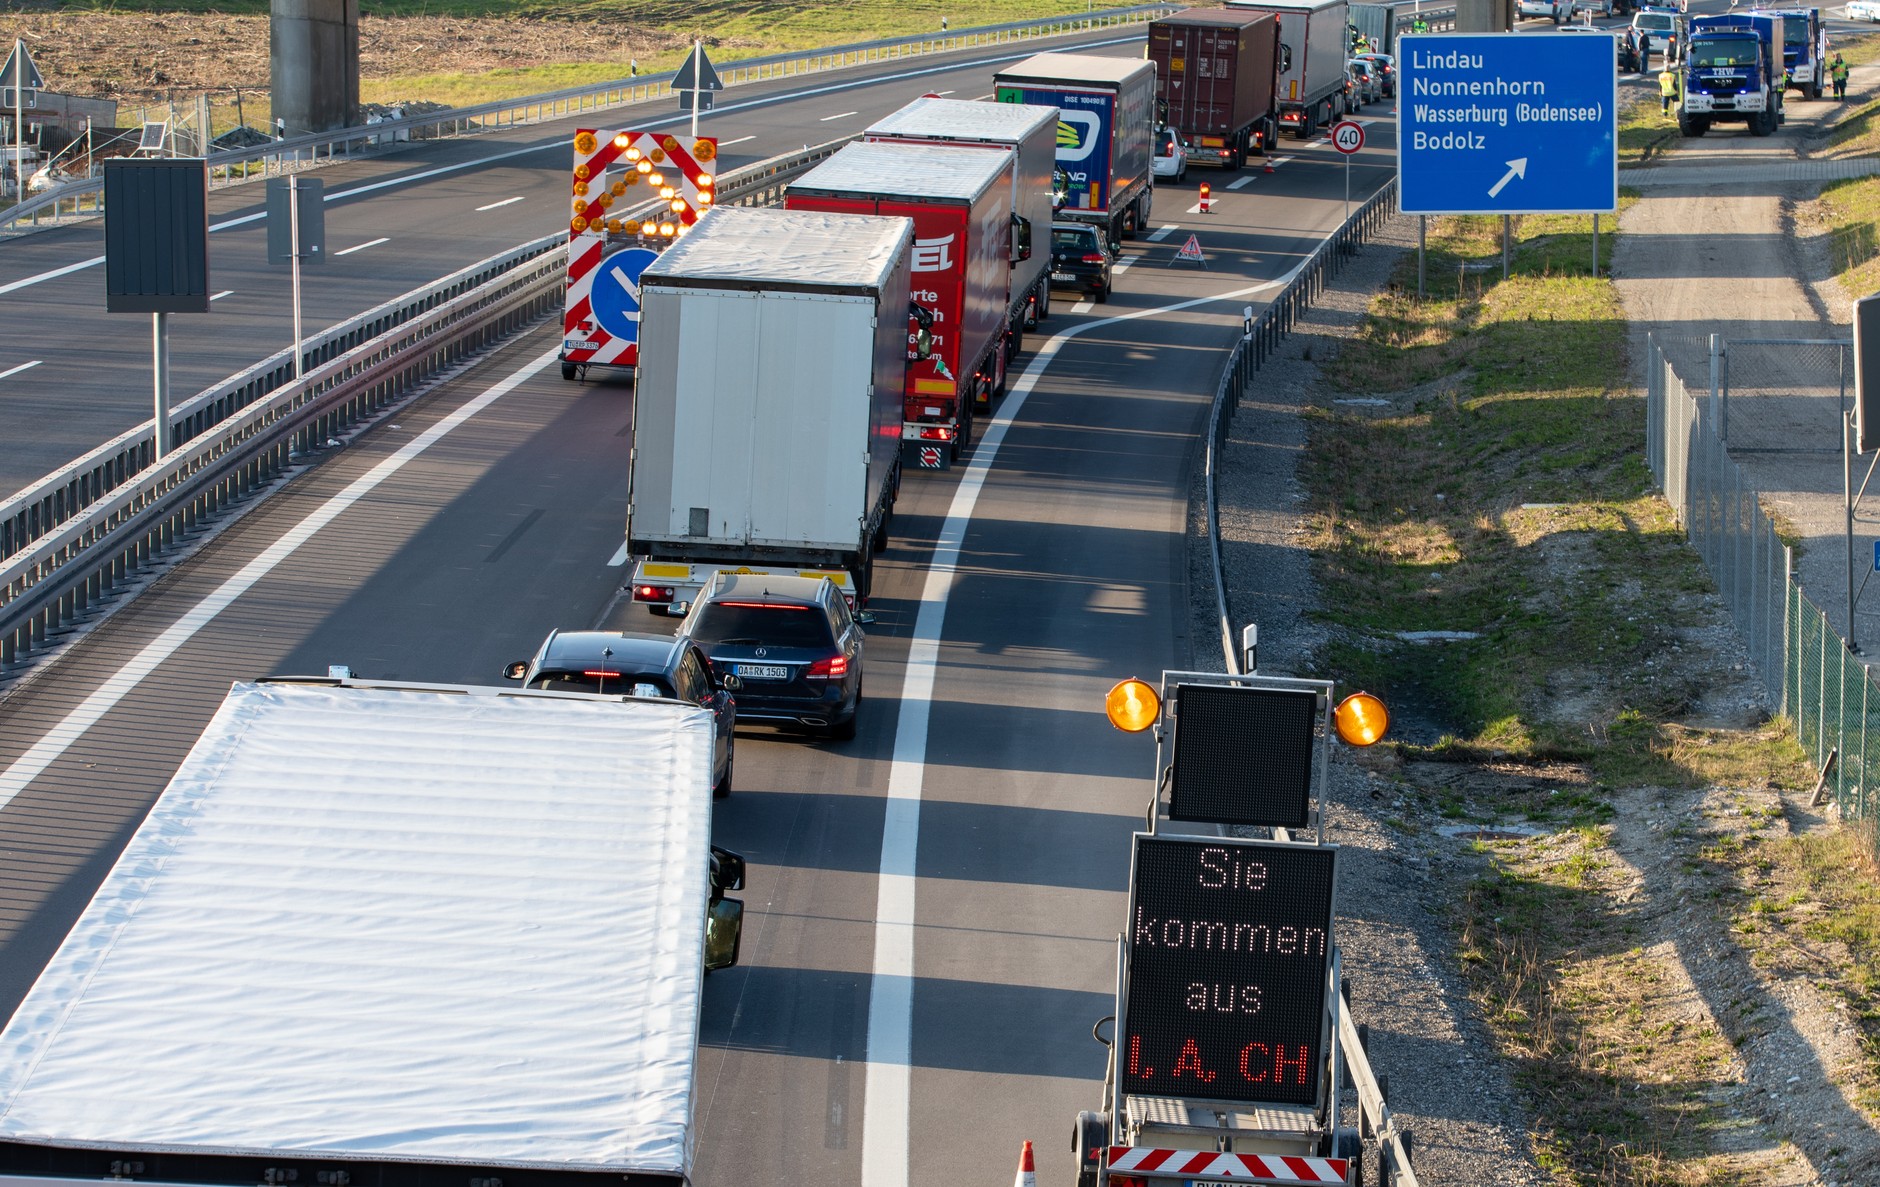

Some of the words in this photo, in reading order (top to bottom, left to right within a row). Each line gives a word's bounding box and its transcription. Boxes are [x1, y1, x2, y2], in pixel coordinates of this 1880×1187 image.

[1413, 50, 1483, 69] Lindau
[1712, 68, 1735, 76] THW
[1413, 76, 1545, 96] Nonnenhorn
[1414, 104, 1508, 127] Wasserburg
[1516, 101, 1602, 123] (Bodensee)
[1339, 130, 1358, 145] 40
[1414, 131, 1486, 150] Bodolz
[766, 668, 786, 677] 1503
[1200, 848, 1267, 890] Sie
[1136, 906, 1325, 956] kommen
[1186, 982, 1262, 1013] aus
[1240, 1042, 1308, 1084] CH
